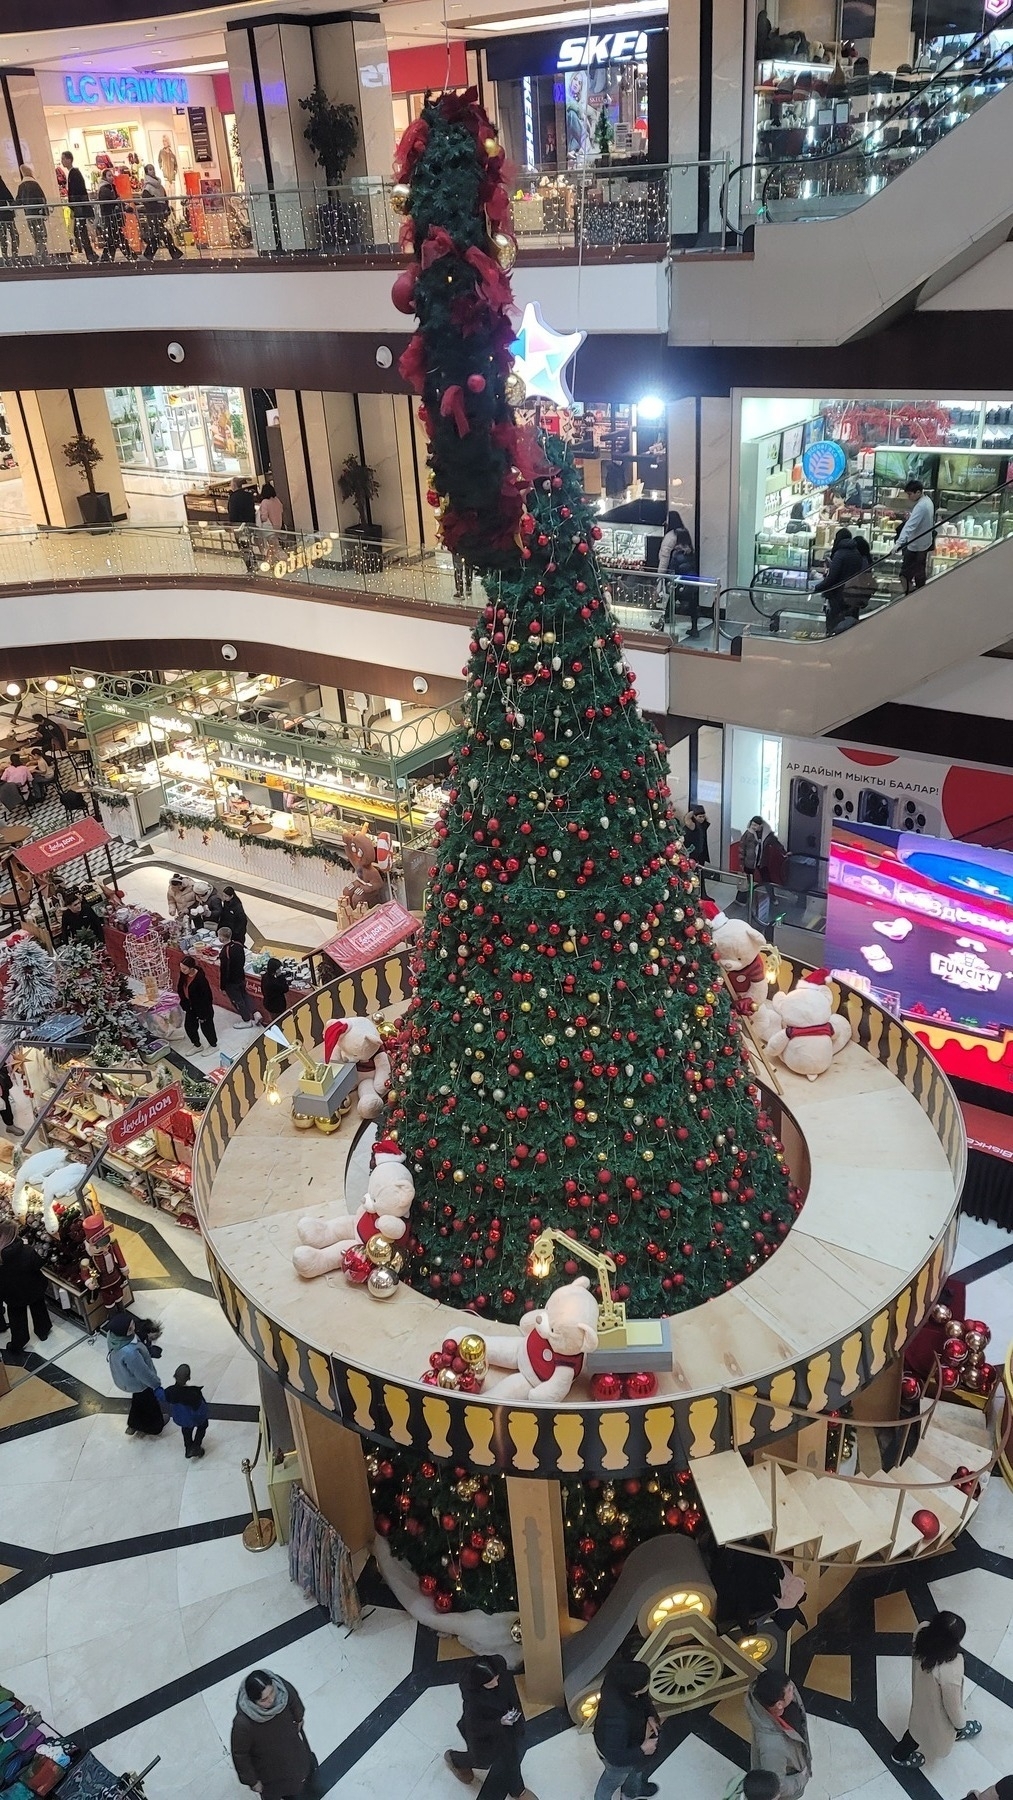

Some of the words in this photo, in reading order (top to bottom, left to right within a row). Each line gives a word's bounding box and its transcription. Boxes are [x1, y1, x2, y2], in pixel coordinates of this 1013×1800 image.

[64, 74, 98, 104] LC
[786, 762, 800, 771] АР
[802, 765, 843, 779] ДАЙЫМ
[845, 772, 887, 787] МЫКТЫ
[889, 780, 939, 796] БААЛАР!
[120, 1110, 149, 1137] Lovely
[148, 1095, 172, 1119] ДОМ
